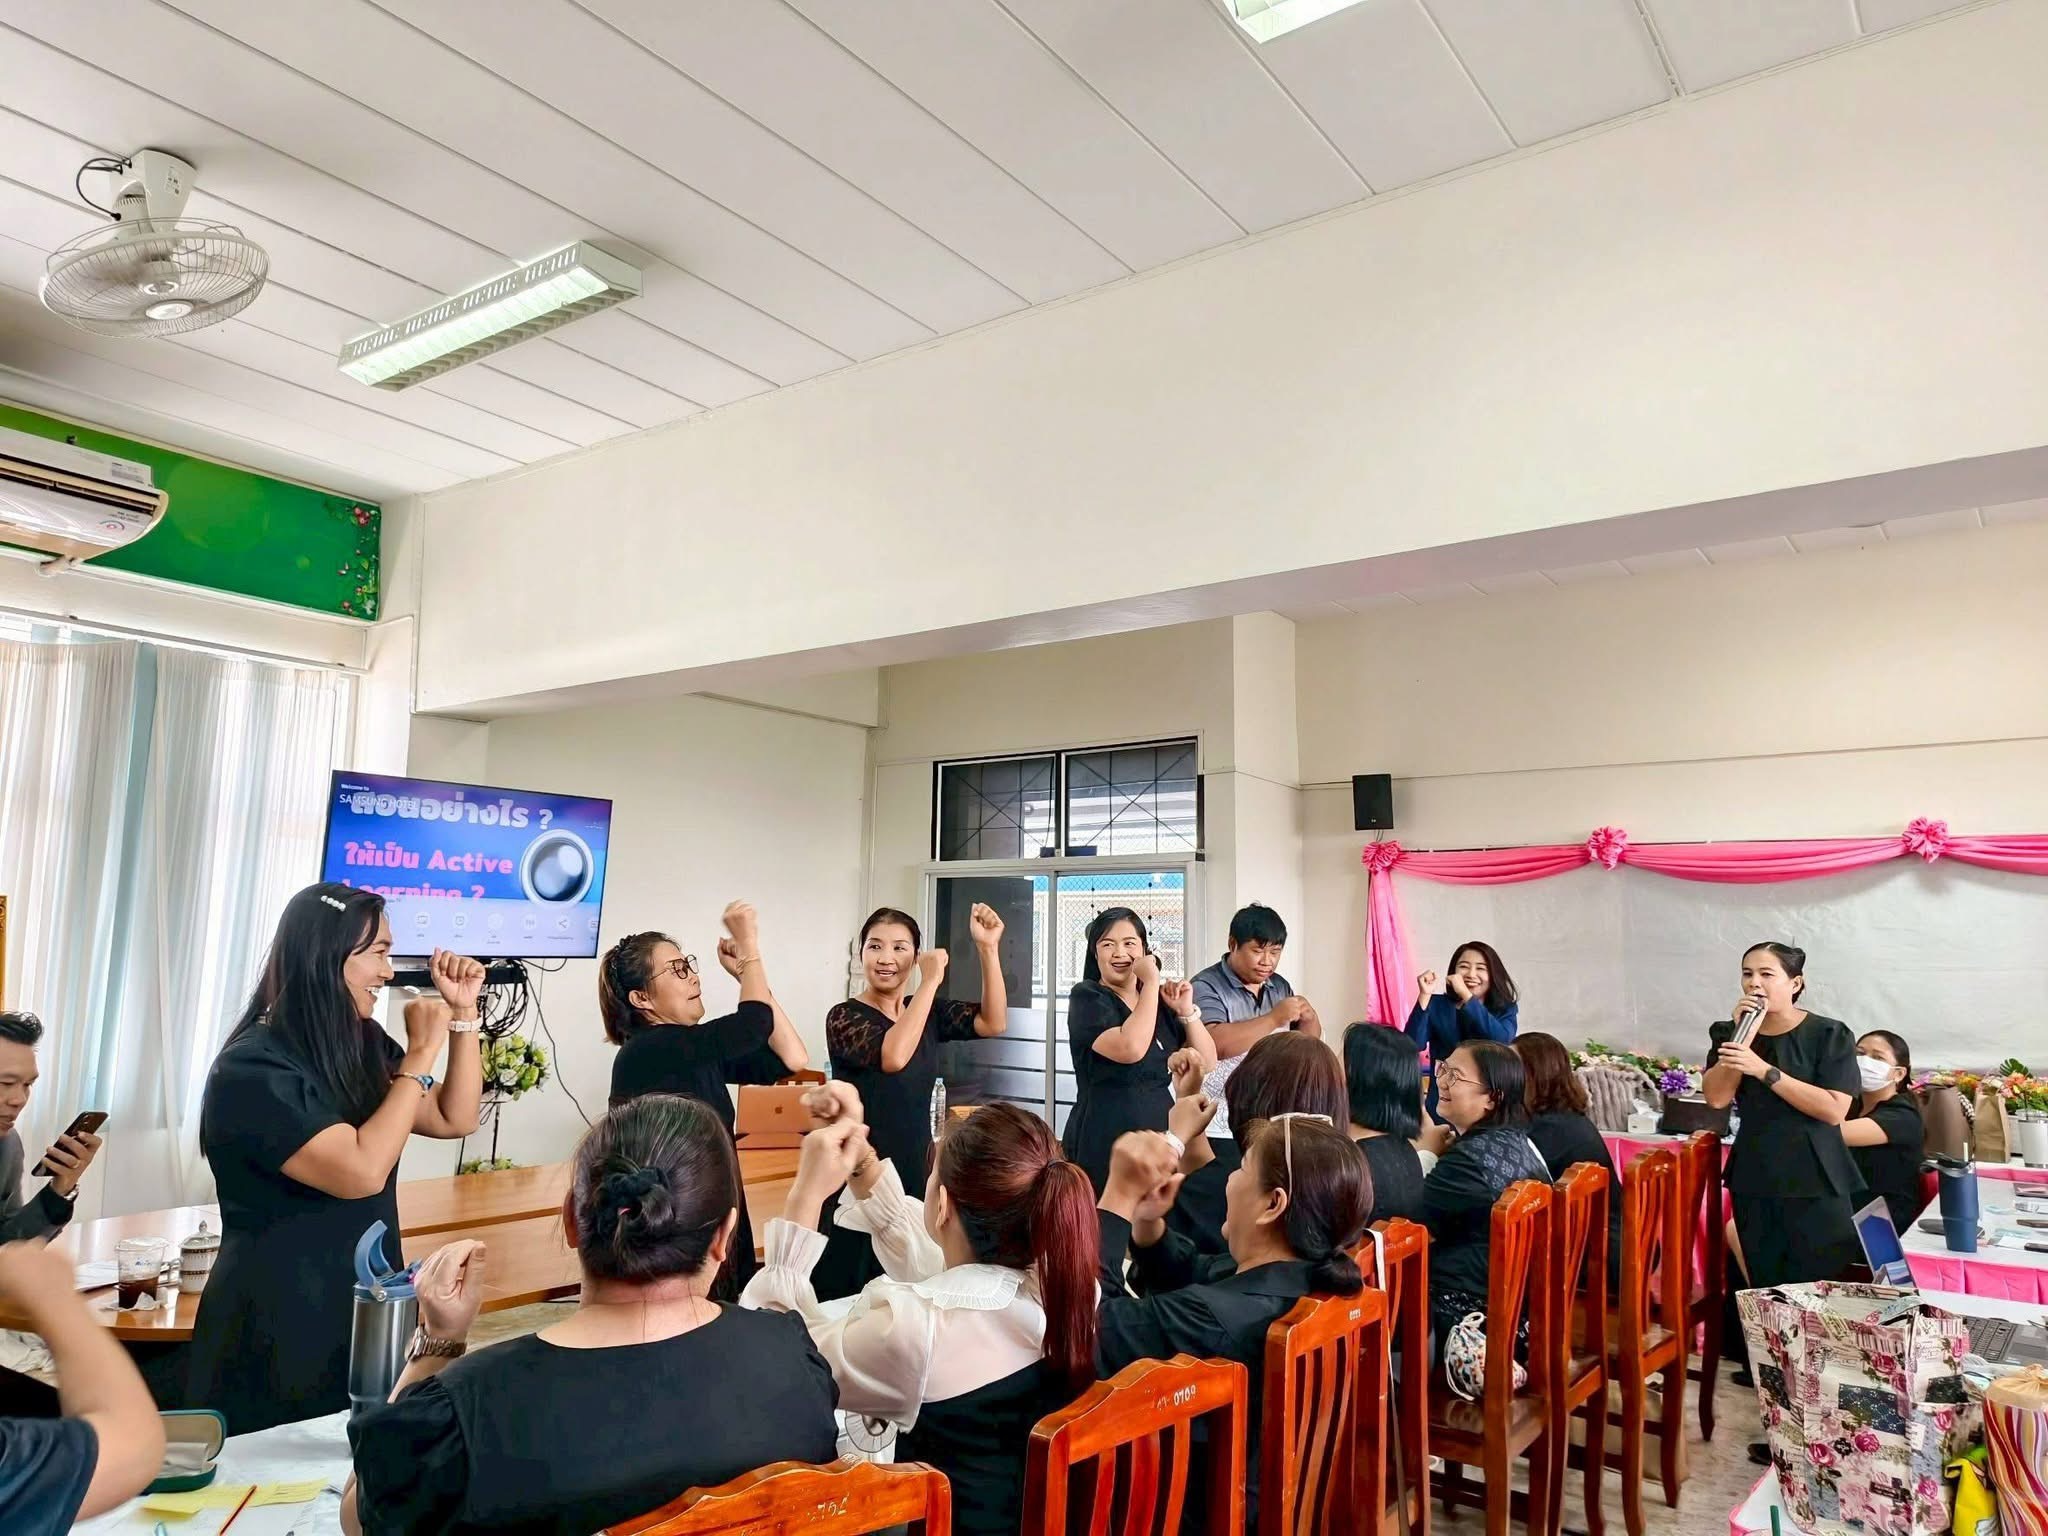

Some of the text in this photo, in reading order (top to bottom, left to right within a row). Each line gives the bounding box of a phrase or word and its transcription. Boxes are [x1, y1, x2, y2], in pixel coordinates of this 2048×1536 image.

[339, 793, 387, 808] SAMSUNG
[539, 808, 554, 830] ?
[344, 840, 514, 875] ให้เป็น Active
